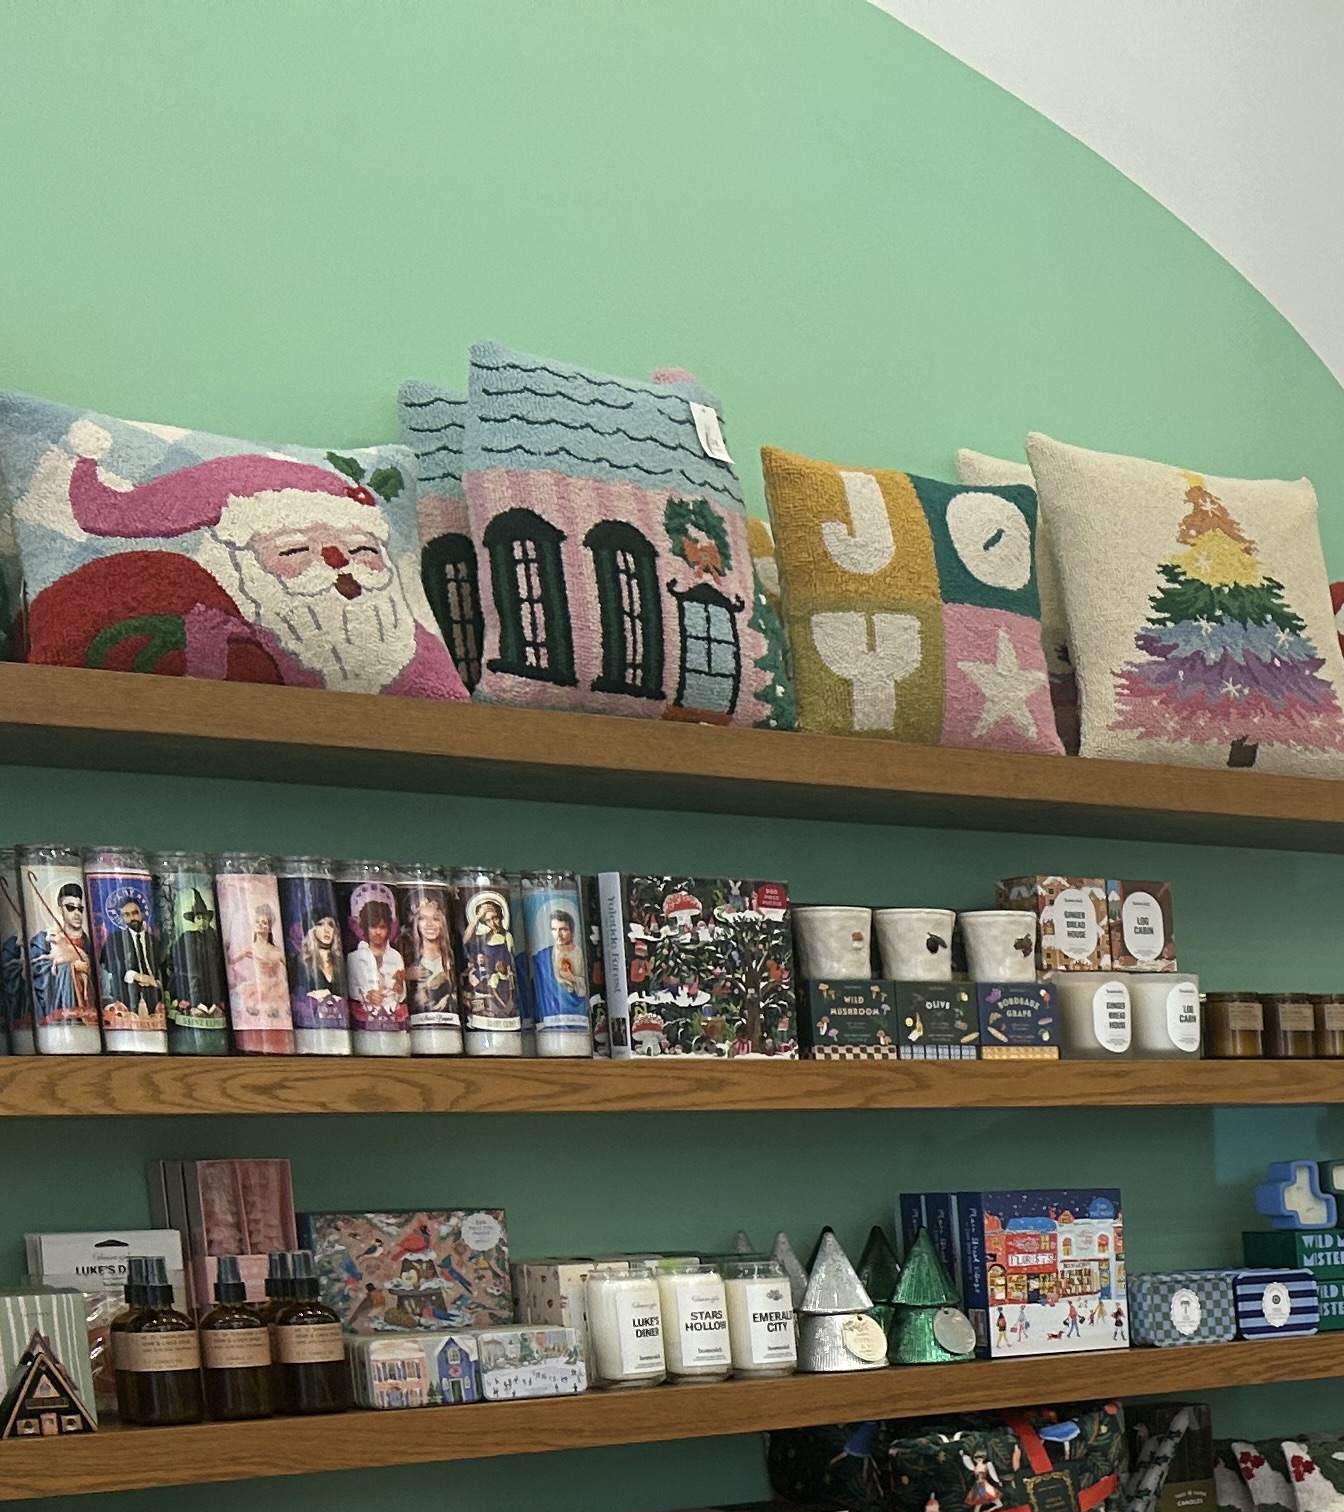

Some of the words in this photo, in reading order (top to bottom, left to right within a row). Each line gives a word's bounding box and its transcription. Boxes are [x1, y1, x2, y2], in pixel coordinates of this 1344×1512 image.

[1302, 1235, 1333, 1249] WILD
[75, 1265, 116, 1276] LUKE'S
[632, 1316, 659, 1328] LUKE'S
[690, 1311, 723, 1321] STARS
[636, 1326, 659, 1338] DINER
[685, 1320, 727, 1332] HOLLOW
[767, 1321, 788, 1332] CITY
